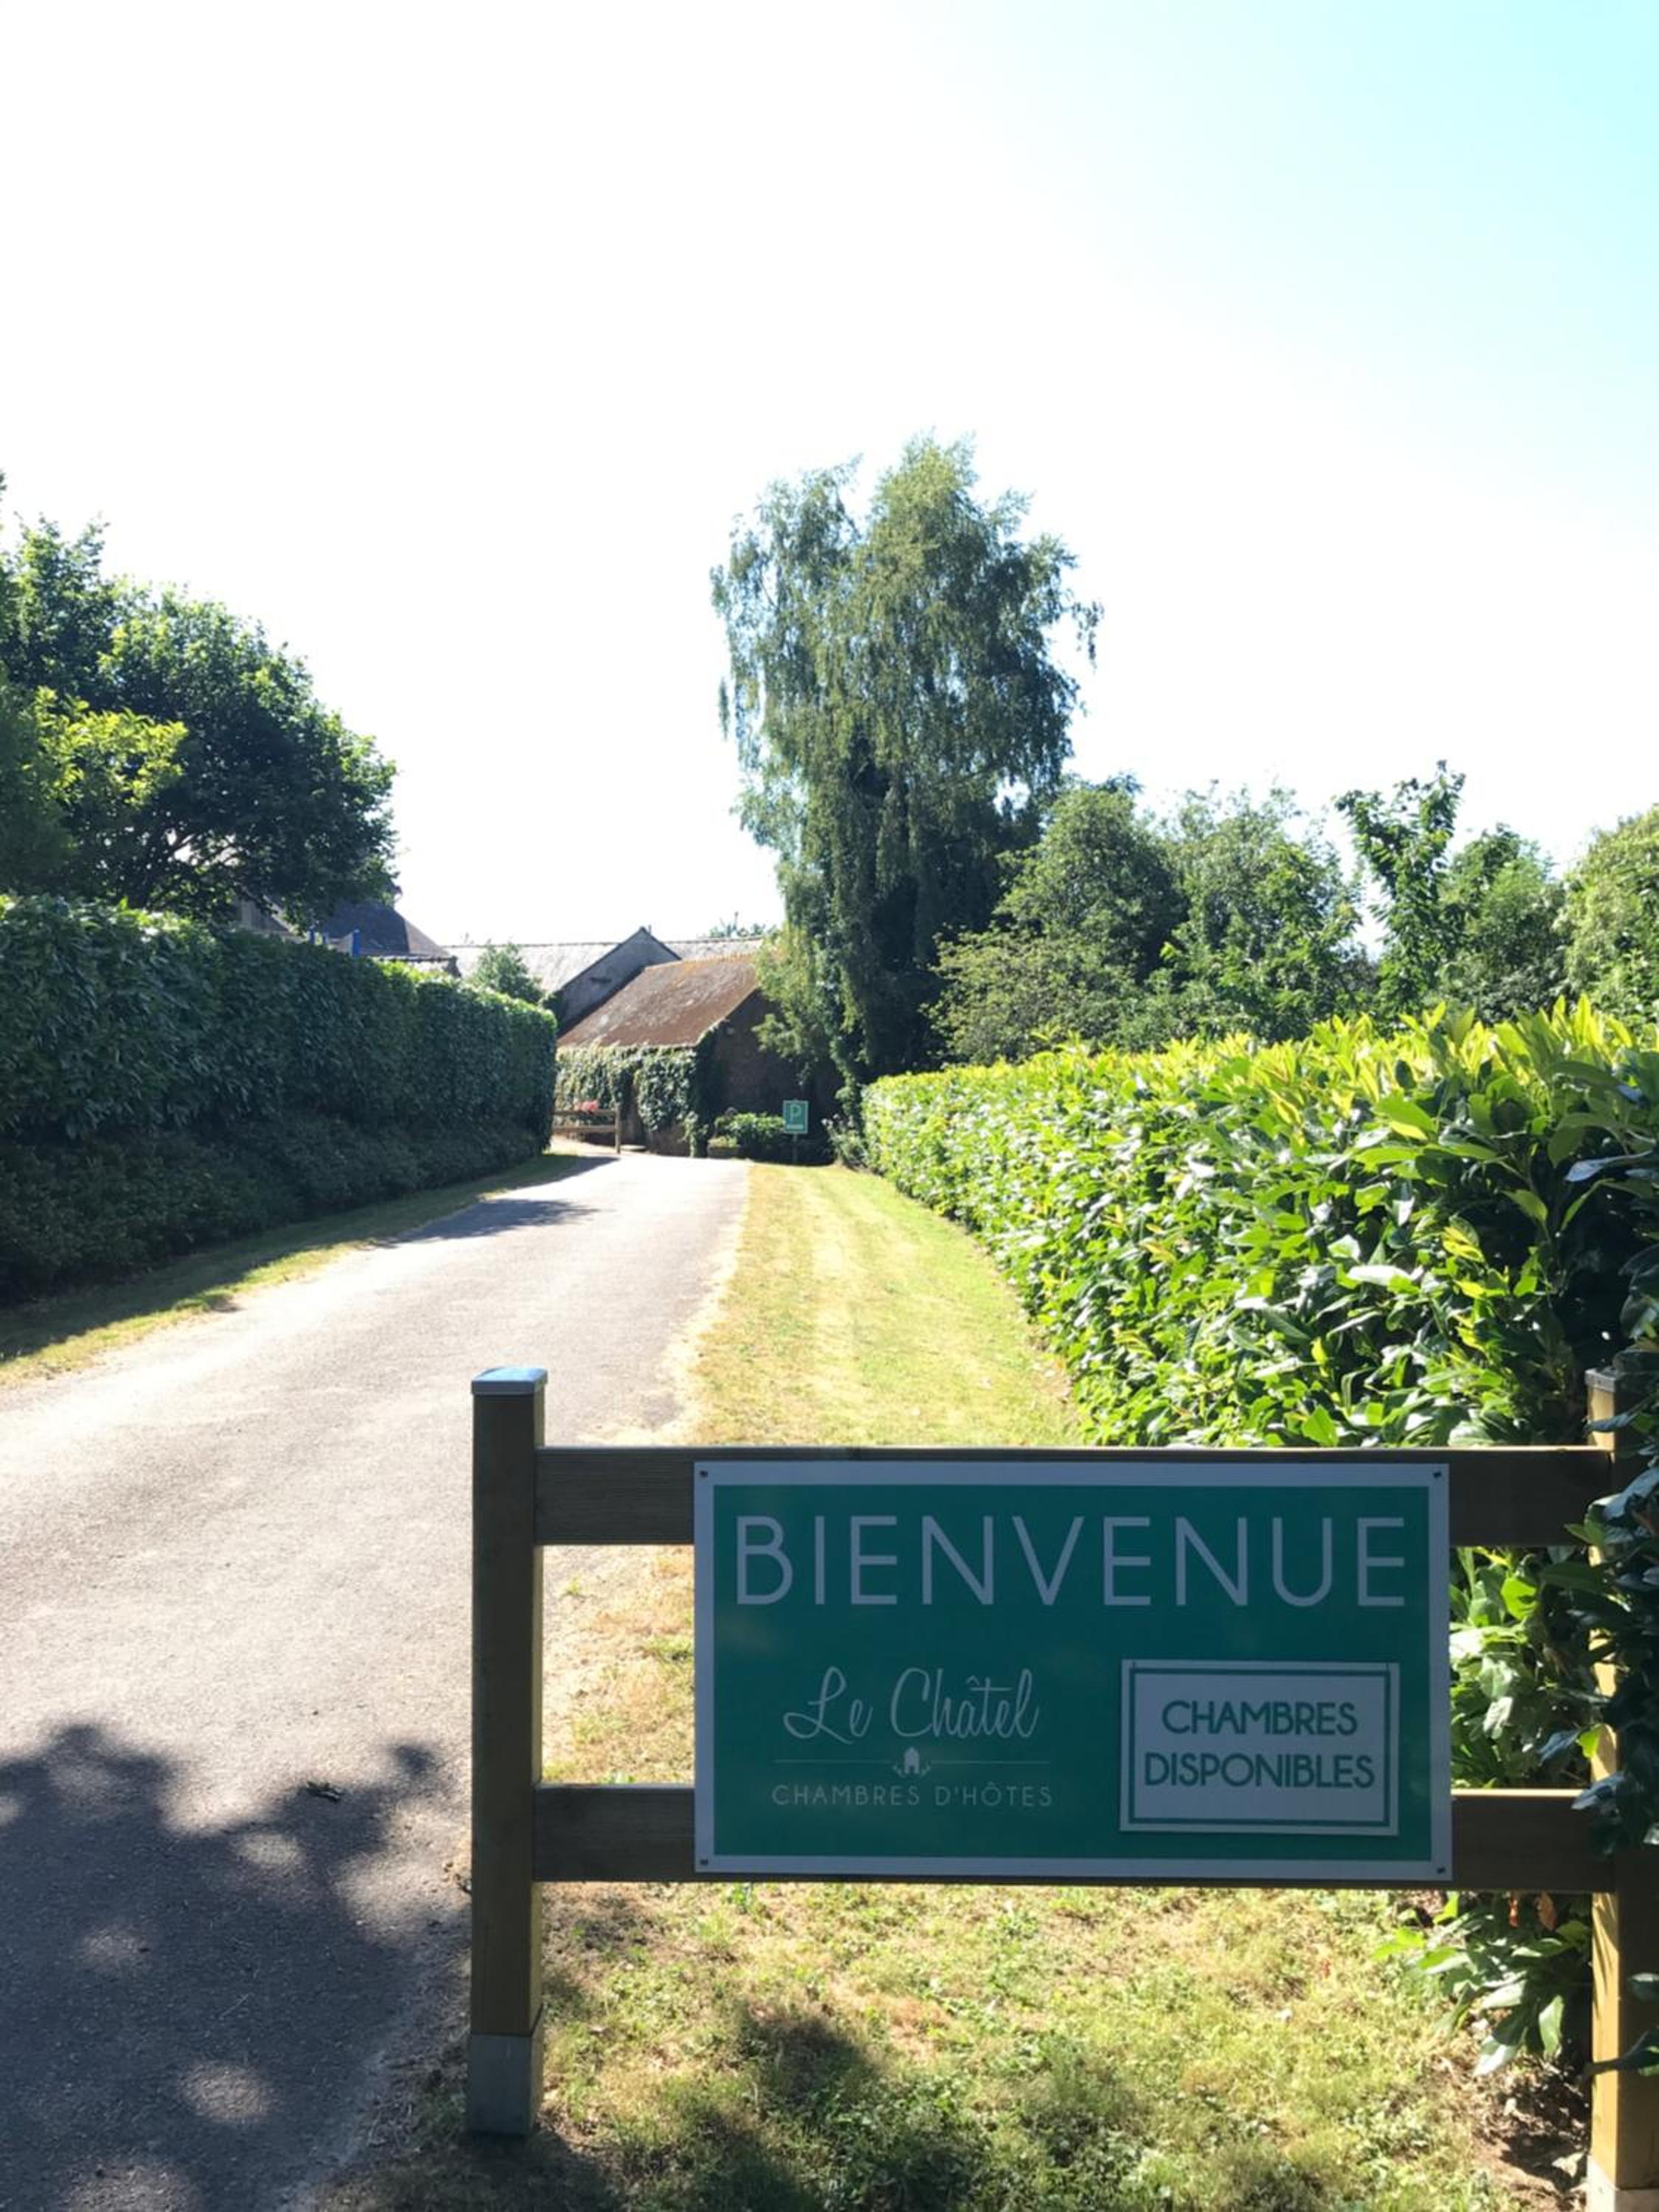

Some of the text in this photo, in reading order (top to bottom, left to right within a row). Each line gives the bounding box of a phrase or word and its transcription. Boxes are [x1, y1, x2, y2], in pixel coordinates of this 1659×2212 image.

[790, 1104, 802, 1122] P
[737, 1515, 1405, 1607] BIENVENUE
[783, 1666, 1039, 1745] Le Châtel
[1161, 1700, 1357, 1736] CHAMBRES
[1144, 1752, 1374, 1790] DISPONIBLES
[772, 1781, 1051, 1806] CHAMBRES D'HÔTES
